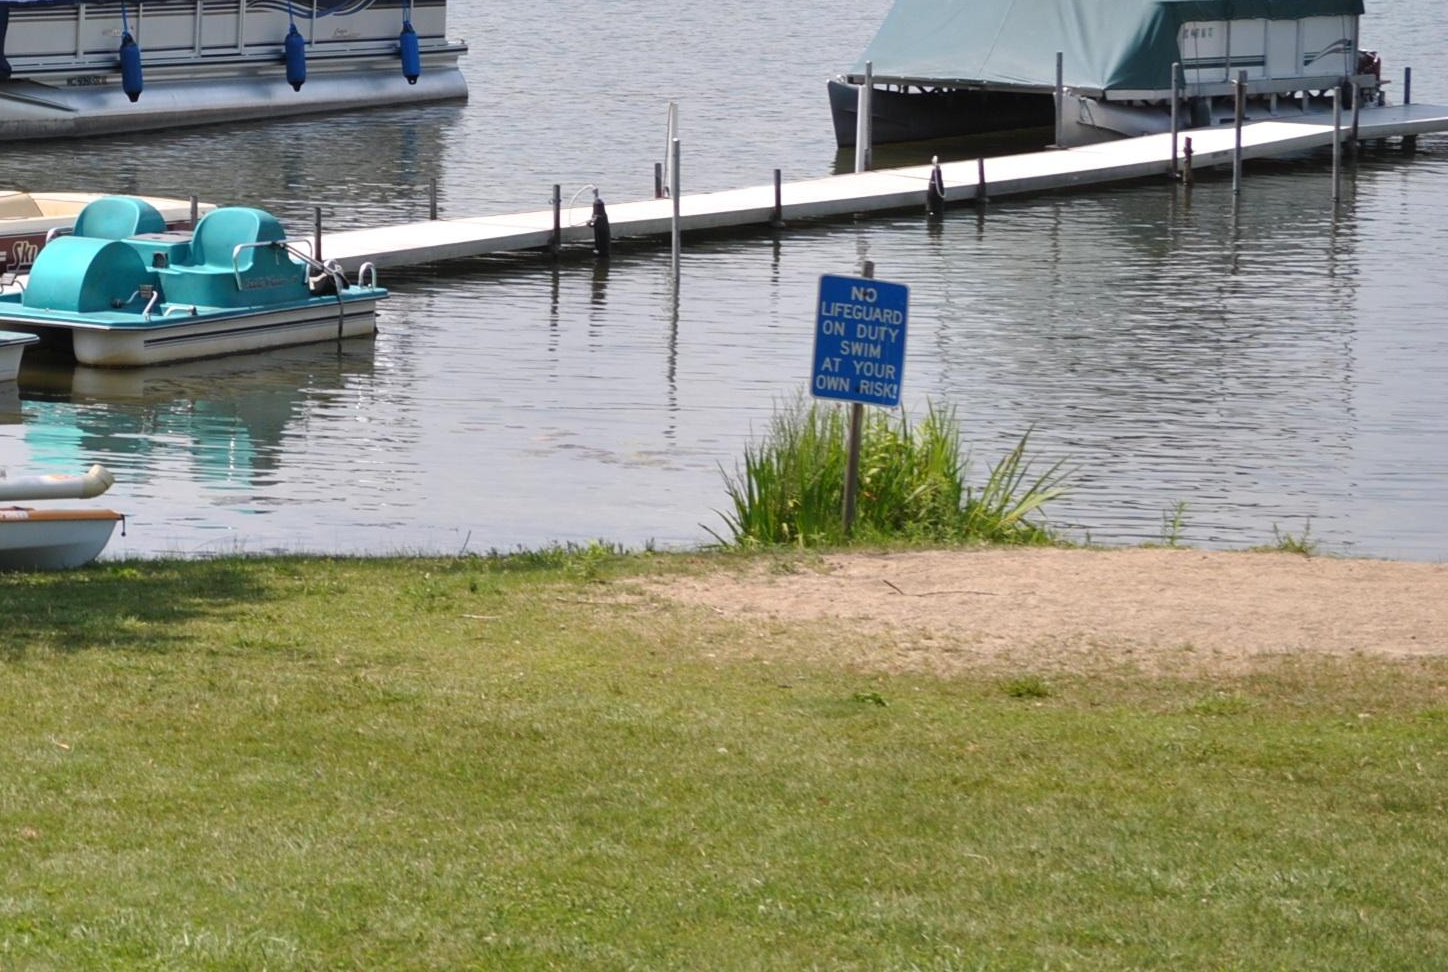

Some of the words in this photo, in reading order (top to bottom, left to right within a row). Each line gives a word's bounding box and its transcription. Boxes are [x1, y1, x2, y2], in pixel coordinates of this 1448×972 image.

[851, 286, 877, 302] NO
[821, 301, 903, 325] LIFEGUARD
[822, 320, 845, 336] ON
[856, 324, 899, 343] DUTY
[840, 340, 881, 358] SWIM
[820, 357, 842, 372] AT
[853, 360, 895, 379] YOUR
[815, 375, 850, 392] OWN
[859, 379, 898, 399] RISK!
